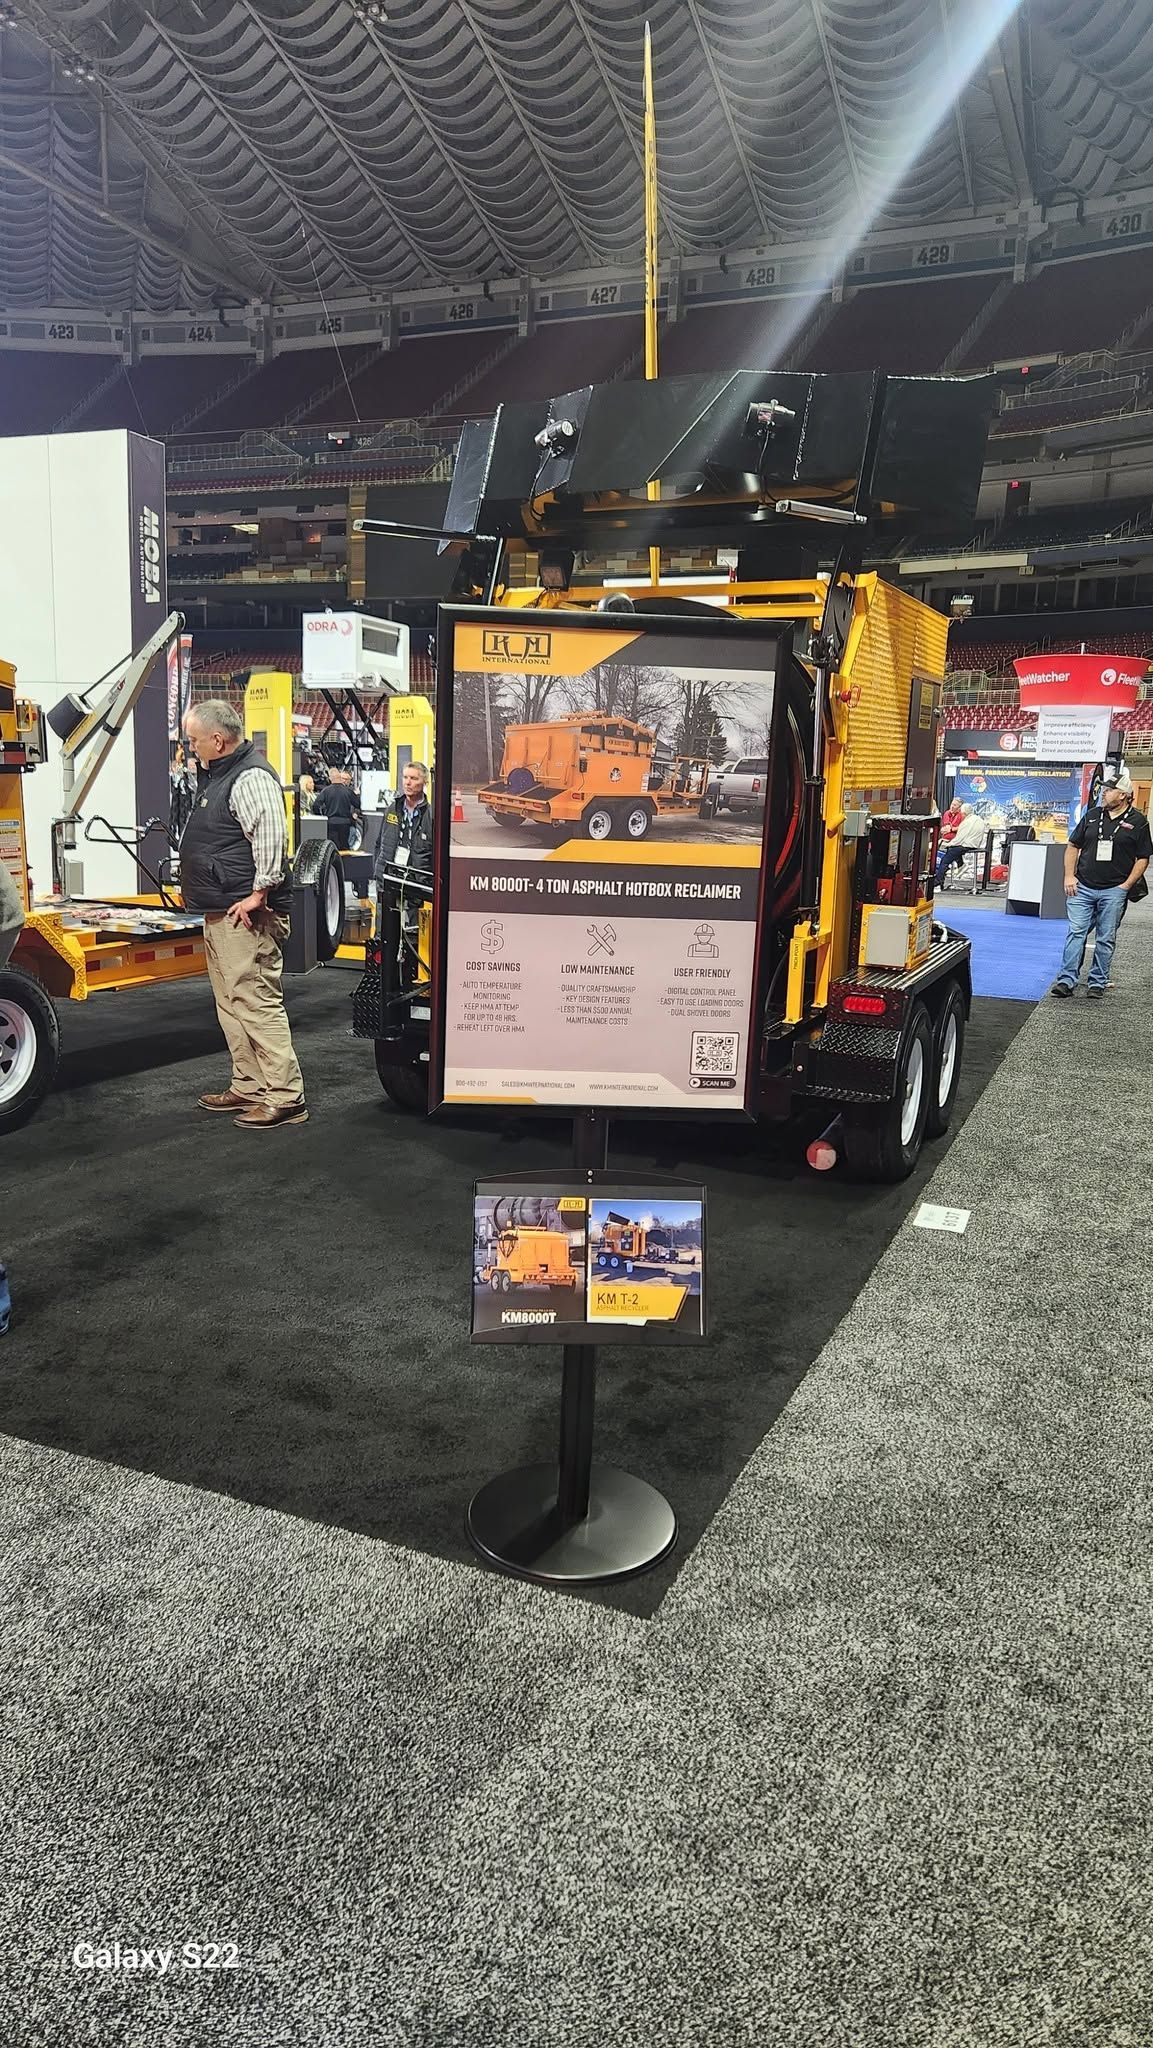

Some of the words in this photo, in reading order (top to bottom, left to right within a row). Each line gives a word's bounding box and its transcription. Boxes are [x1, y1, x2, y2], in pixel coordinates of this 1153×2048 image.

[1106, 213, 1143, 237] 430
[917, 245, 950, 265] 429
[746, 266, 775, 286] 428
[591, 287, 617, 303] 427
[450, 304, 473, 320] 426
[319, 317, 342, 334] 425
[48, 324, 75, 340] 423
[188, 327, 214, 342] 424
[144, 505, 161, 603] MOBA
[307, 620, 338, 632] ODRA
[482, 656, 551, 665] INTERNATIONAL
[1028, 770, 1071, 778] INSTALLATION
[470, 876, 489, 891] KM
[536, 879, 544, 893] 4
[546, 879, 569, 894] TON
[571, 880, 624, 896] ASPHALT
[625, 881, 672, 898] HOTBOX
[674, 883, 741, 900] RECLAIMER
[466, 961, 487, 971] COST
[488, 962, 521, 972] SAVINGS
[561, 964, 578, 974] LOW
[580, 965, 635, 976] MAINTENANCE
[674, 967, 694, 978] USER
[695, 968, 731, 979] FRIENDLY
[480, 981, 522, 990] TEMPERATURE
[586, 985, 637, 994] CRAFTSMANSHIP
[473, 992, 511, 1001] MONITORING
[690, 988, 717, 996] CONTROL
[718, 988, 737, 997] PANEL
[579, 996, 600, 1004] DESIGN
[601, 996, 631, 1005] FEATURES
[676, 998, 684, 1006] TO
[685, 998, 697, 1006] USE
[697, 999, 723, 1007] LOADING
[724, 999, 744, 1008] DOORS
[480, 1003, 494, 1011] HMA
[503, 1004, 519, 1012] TEMP
[576, 1006, 592, 1014] THAN
[593, 1006, 609, 1015] $500
[610, 1007, 633, 1015] ANNUAL
[464, 1013, 476, 1021] FOR
[477, 1013, 486, 1021] UP
[686, 1009, 709, 1017] SHOVEL
[710, 1009, 731, 1018] DOORS
[566, 1017, 607, 1025] MAINTENANCE
[608, 1018, 629, 1026] COSTS
[480, 1024, 493, 1032] LEFT
[495, 1025, 511, 1033] OVER
[512, 1025, 526, 1033] HMA
[597, 1292, 617, 1305] KM
[620, 1292, 639, 1305] T-2
[501, 1311, 557, 1324] KM8000T
